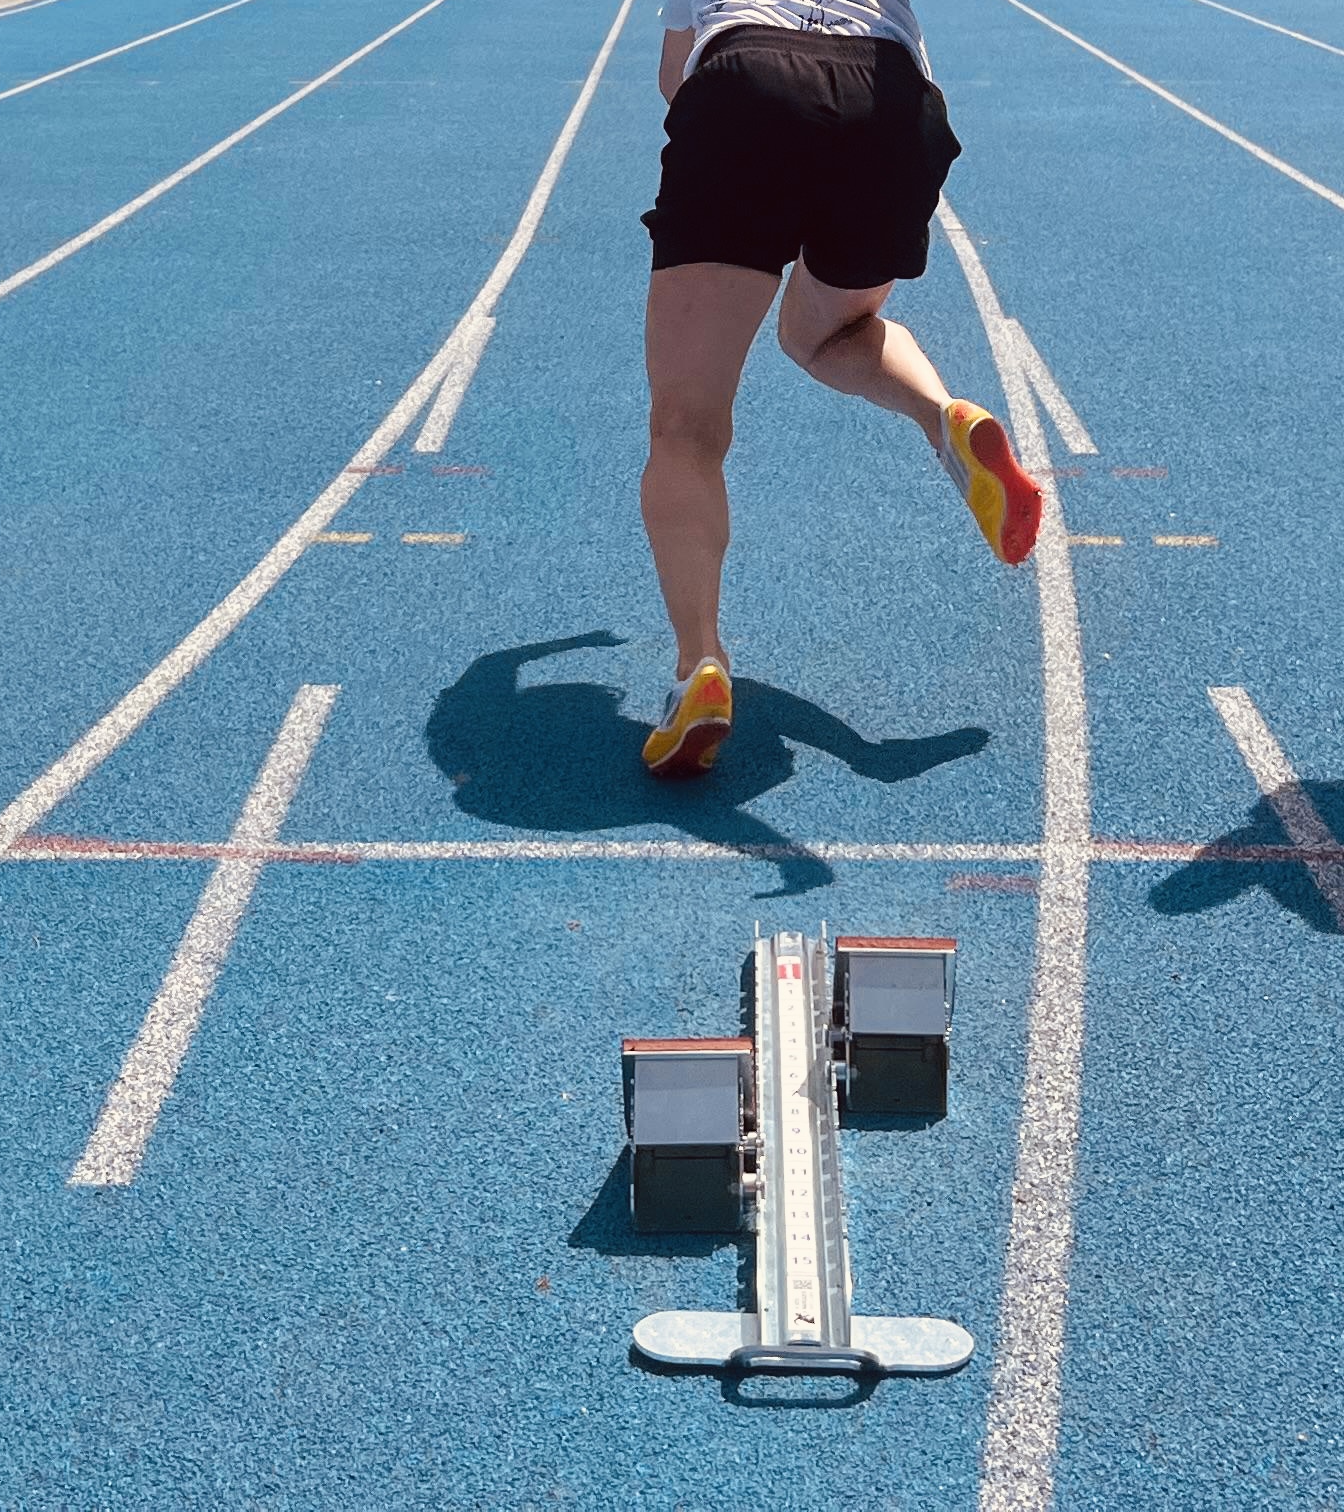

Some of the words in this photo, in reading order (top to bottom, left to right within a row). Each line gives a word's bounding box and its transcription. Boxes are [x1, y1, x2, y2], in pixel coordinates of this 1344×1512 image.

[791, 1189, 808, 1197] 12
[793, 1233, 811, 1241] 14
[793, 1256, 813, 1265] 15
